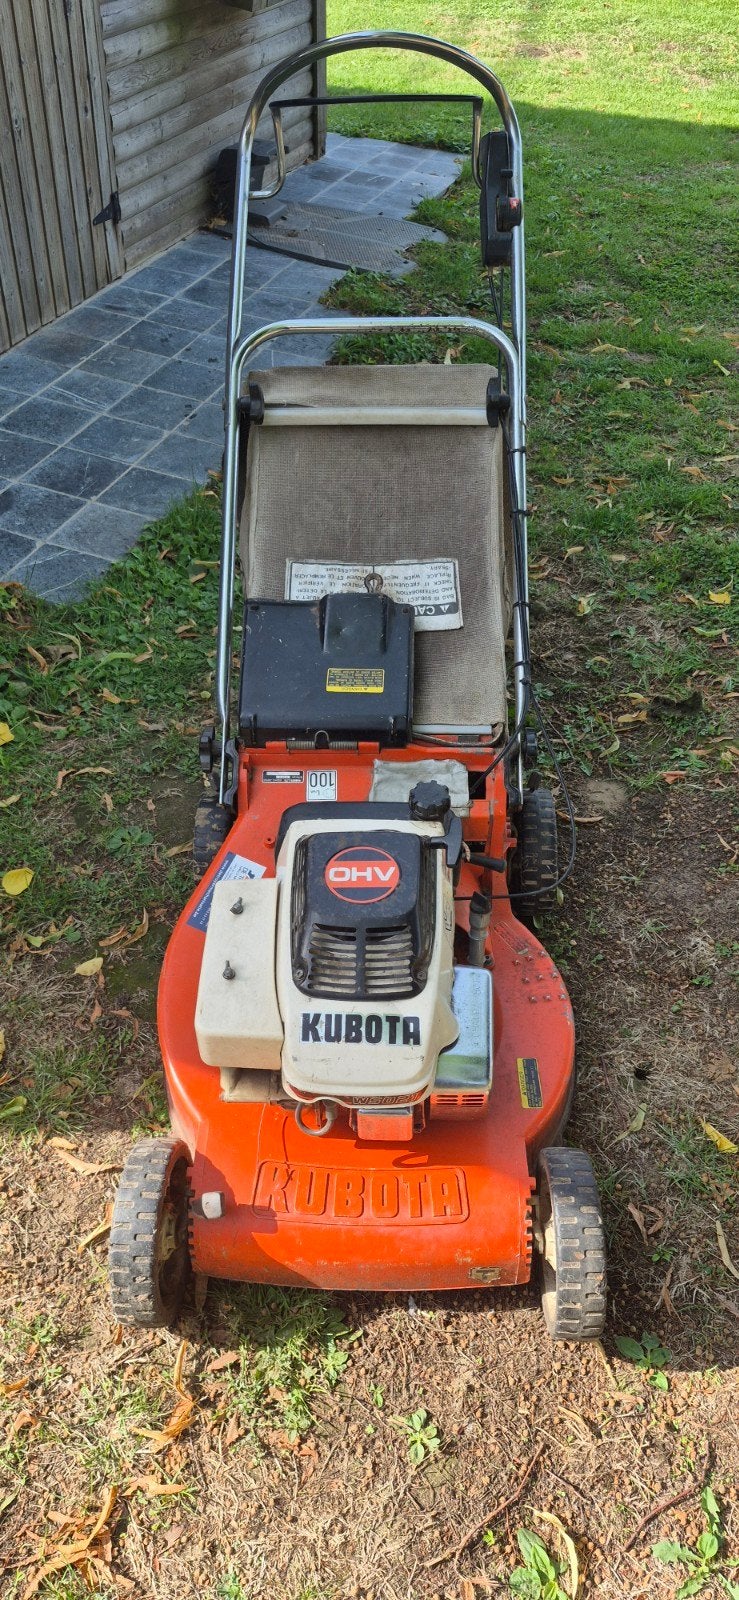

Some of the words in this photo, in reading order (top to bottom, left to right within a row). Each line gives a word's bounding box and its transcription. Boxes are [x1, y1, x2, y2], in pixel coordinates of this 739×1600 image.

[309, 773, 335, 787] 100
[328, 866, 396, 882] OHV
[301, 1012, 421, 1046] KUBOTA
[259, 1162, 463, 1219] KUBOTA
